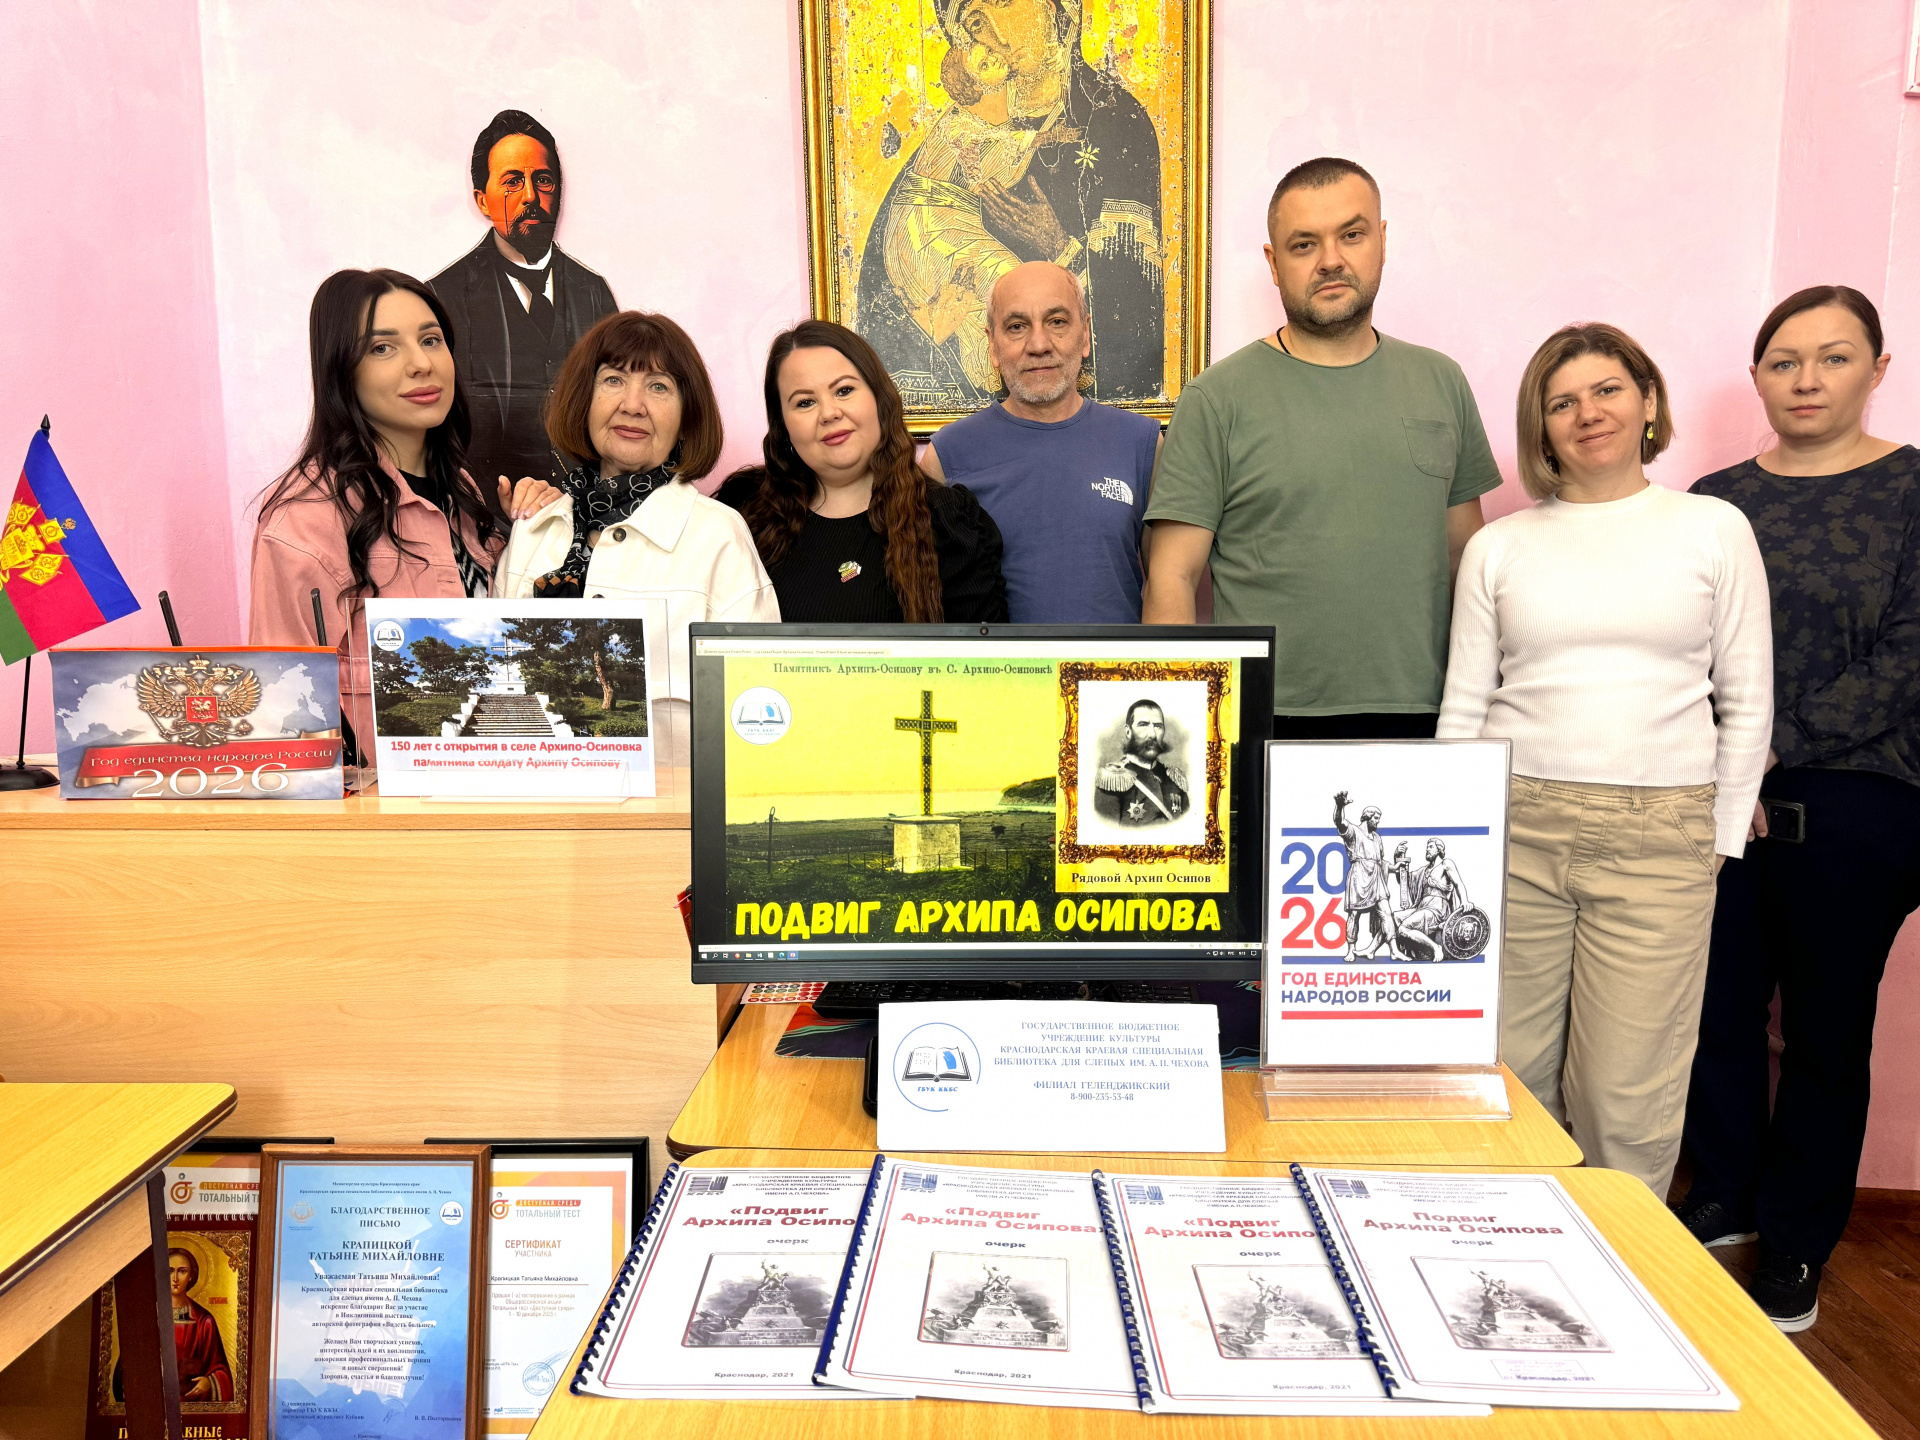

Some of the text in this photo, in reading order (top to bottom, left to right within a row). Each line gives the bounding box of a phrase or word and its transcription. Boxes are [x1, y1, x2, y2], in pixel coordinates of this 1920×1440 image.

[1103, 476, 1120, 487] THE
[1091, 482, 1121, 494] NORTH
[1101, 490, 1121, 502] FACE
[774, 663, 832, 673] Памятникъ
[947, 664, 958, 674] С.
[391, 741, 642, 753] 150 лет с открытия в селе Архипо-Осиповка
[91, 749, 332, 767] Год единства народов России
[413, 757, 621, 769] памятника солдату Архипу Осипову
[131, 763, 289, 798] 2026
[1280, 841, 1349, 895] 20
[1071, 873, 1211, 885] Рядовой Архип Осипов
[735, 898, 1221, 940] ПОДВИГ АРХИПА ОСИПОВА
[1280, 896, 1347, 949] 26
[1281, 971, 1422, 987] ГОД ЕДИНСТВА
[1281, 989, 1451, 1005] НАРОДОВ РОССИИ
[1021, 1022, 1180, 1031] ГОСУДАРСТВЕННОЕ БЮДЖЕТНОЕ
[1041, 1034, 1105, 1042] УЧРЕЖДЕНИЕ
[1000, 1046, 1081, 1054] КРАСНОДАРСКАЯ
[1132, 1047, 1203, 1055] СПЕЦИАЛЬНАЯ
[1061, 1058, 1080, 1066] ДЛЯ
[1084, 1058, 1125, 1066] СЛЕПЫХ
[1129, 1059, 1147, 1067] ИМ.
[1149, 1059, 1158, 1067] А.
[1171, 1059, 1209, 1067] ЧЕХОВА
[1034, 1080, 1170, 1090] ФИЛИАЛ ГЕЛЕНДЖИКСКИЙ
[1070, 1092, 1134, 1101] 8-900-235-53-48
[199, 1192, 250, 1202] ТОТАЛЬНЫЙ
[330, 1206, 430, 1215] БЛАГОДАРСТВЕННОЕ
[516, 1208, 580, 1218] ТОТАЛЬНЫЙ ТЕСТ
[730, 1206, 829, 1216] «Подвиг
[945, 1207, 1040, 1220] «Подвиг
[682, 1216, 856, 1228] Архипа Осипо
[900, 1212, 987, 1228] Архипа
[1184, 1218, 1280, 1228] «Подвиг
[1413, 1212, 1497, 1224] Подвиг
[360, 1220, 400, 1228] ПИСЬМО
[1364, 1219, 1564, 1235] Архипа Осипова
[1144, 1226, 1316, 1238] Архипа Осипо
[342, 1240, 412, 1250] КРАПИЦКОЙ
[505, 1240, 562, 1249] СЕРТИФИКАТ
[308, 1250, 444, 1261] ТАТЬЯНЕ МИХАЙЛОВНЕ
[1239, 1250, 1281, 1258] очерк
[954, 1369, 1007, 1378] Краснодар,
